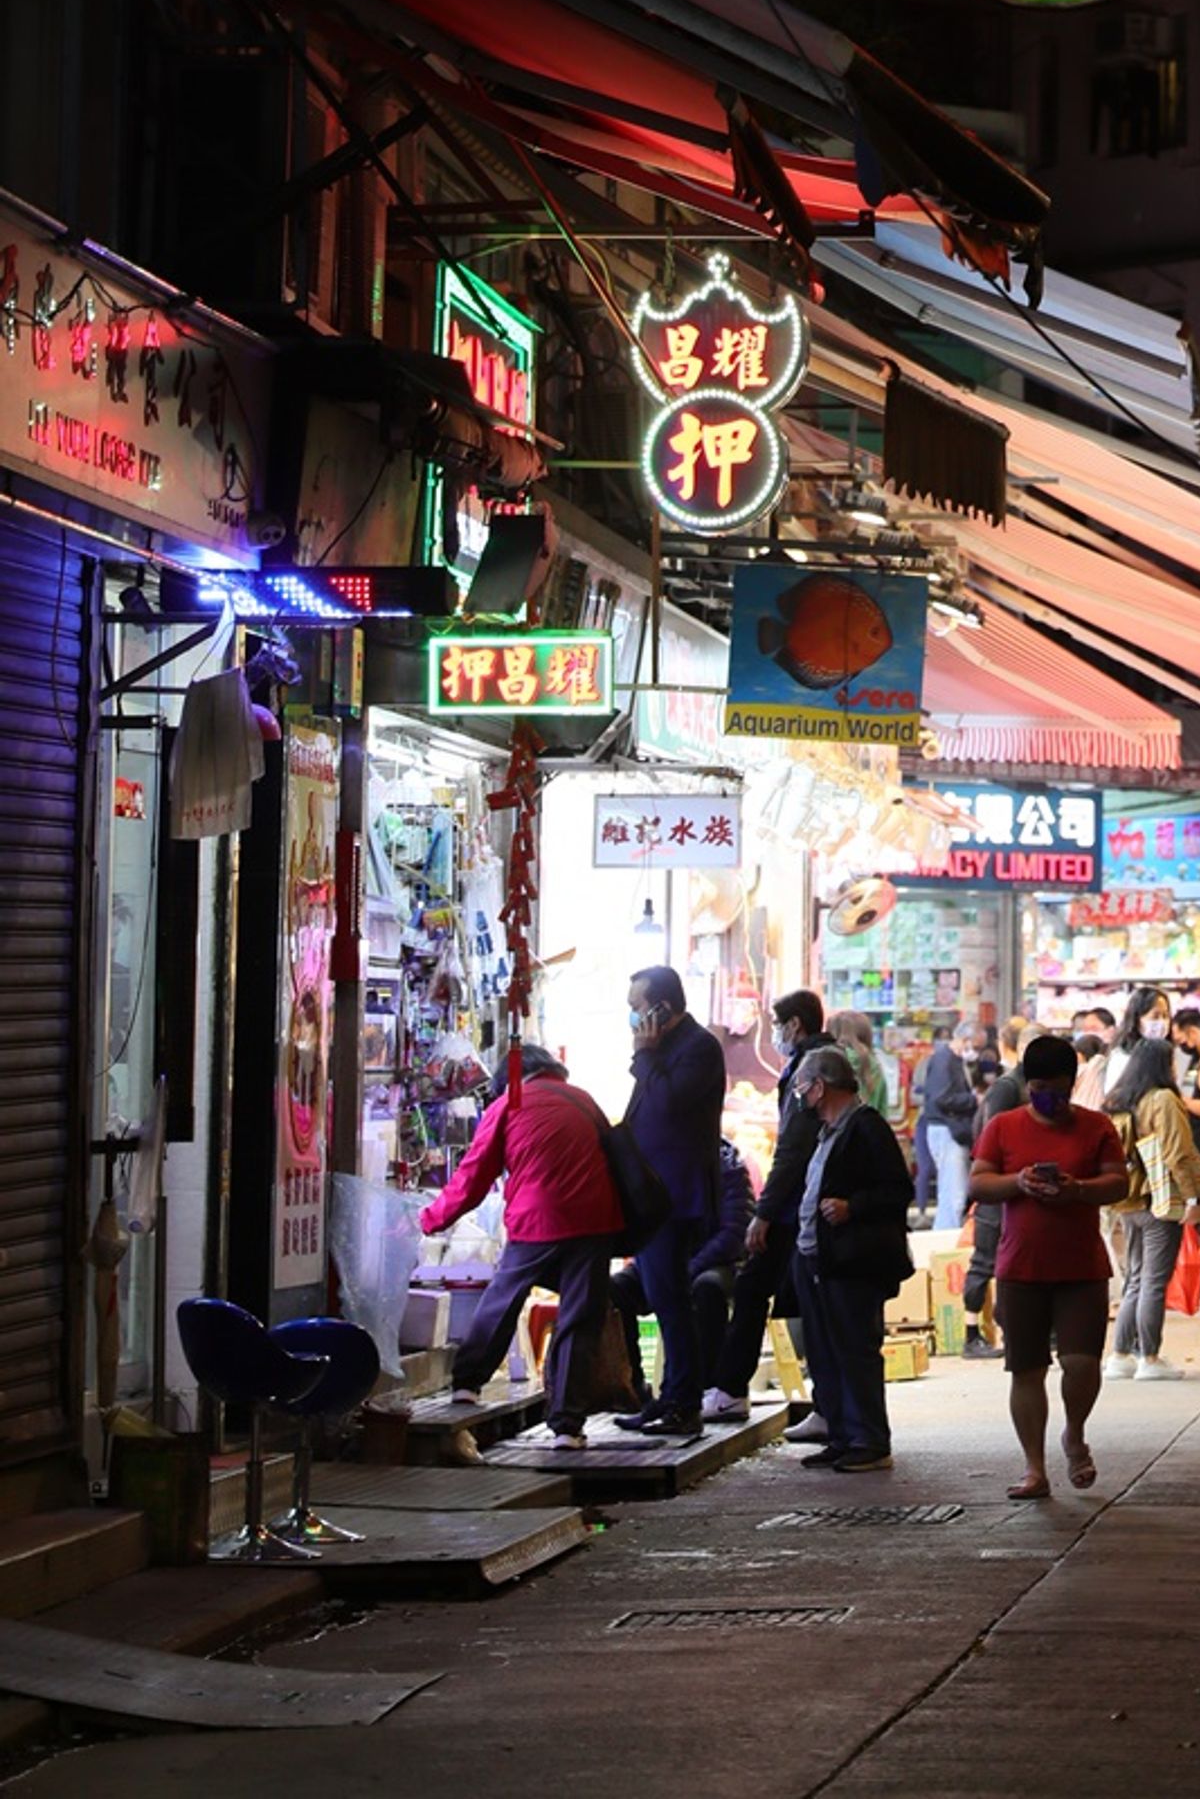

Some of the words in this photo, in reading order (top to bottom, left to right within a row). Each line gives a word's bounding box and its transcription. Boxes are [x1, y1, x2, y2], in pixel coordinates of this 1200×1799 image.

[667, 412, 758, 508] 押
[725, 711, 840, 738] Aquarium
[846, 718, 915, 743] World
[994, 852, 1094, 883] LIMITED
